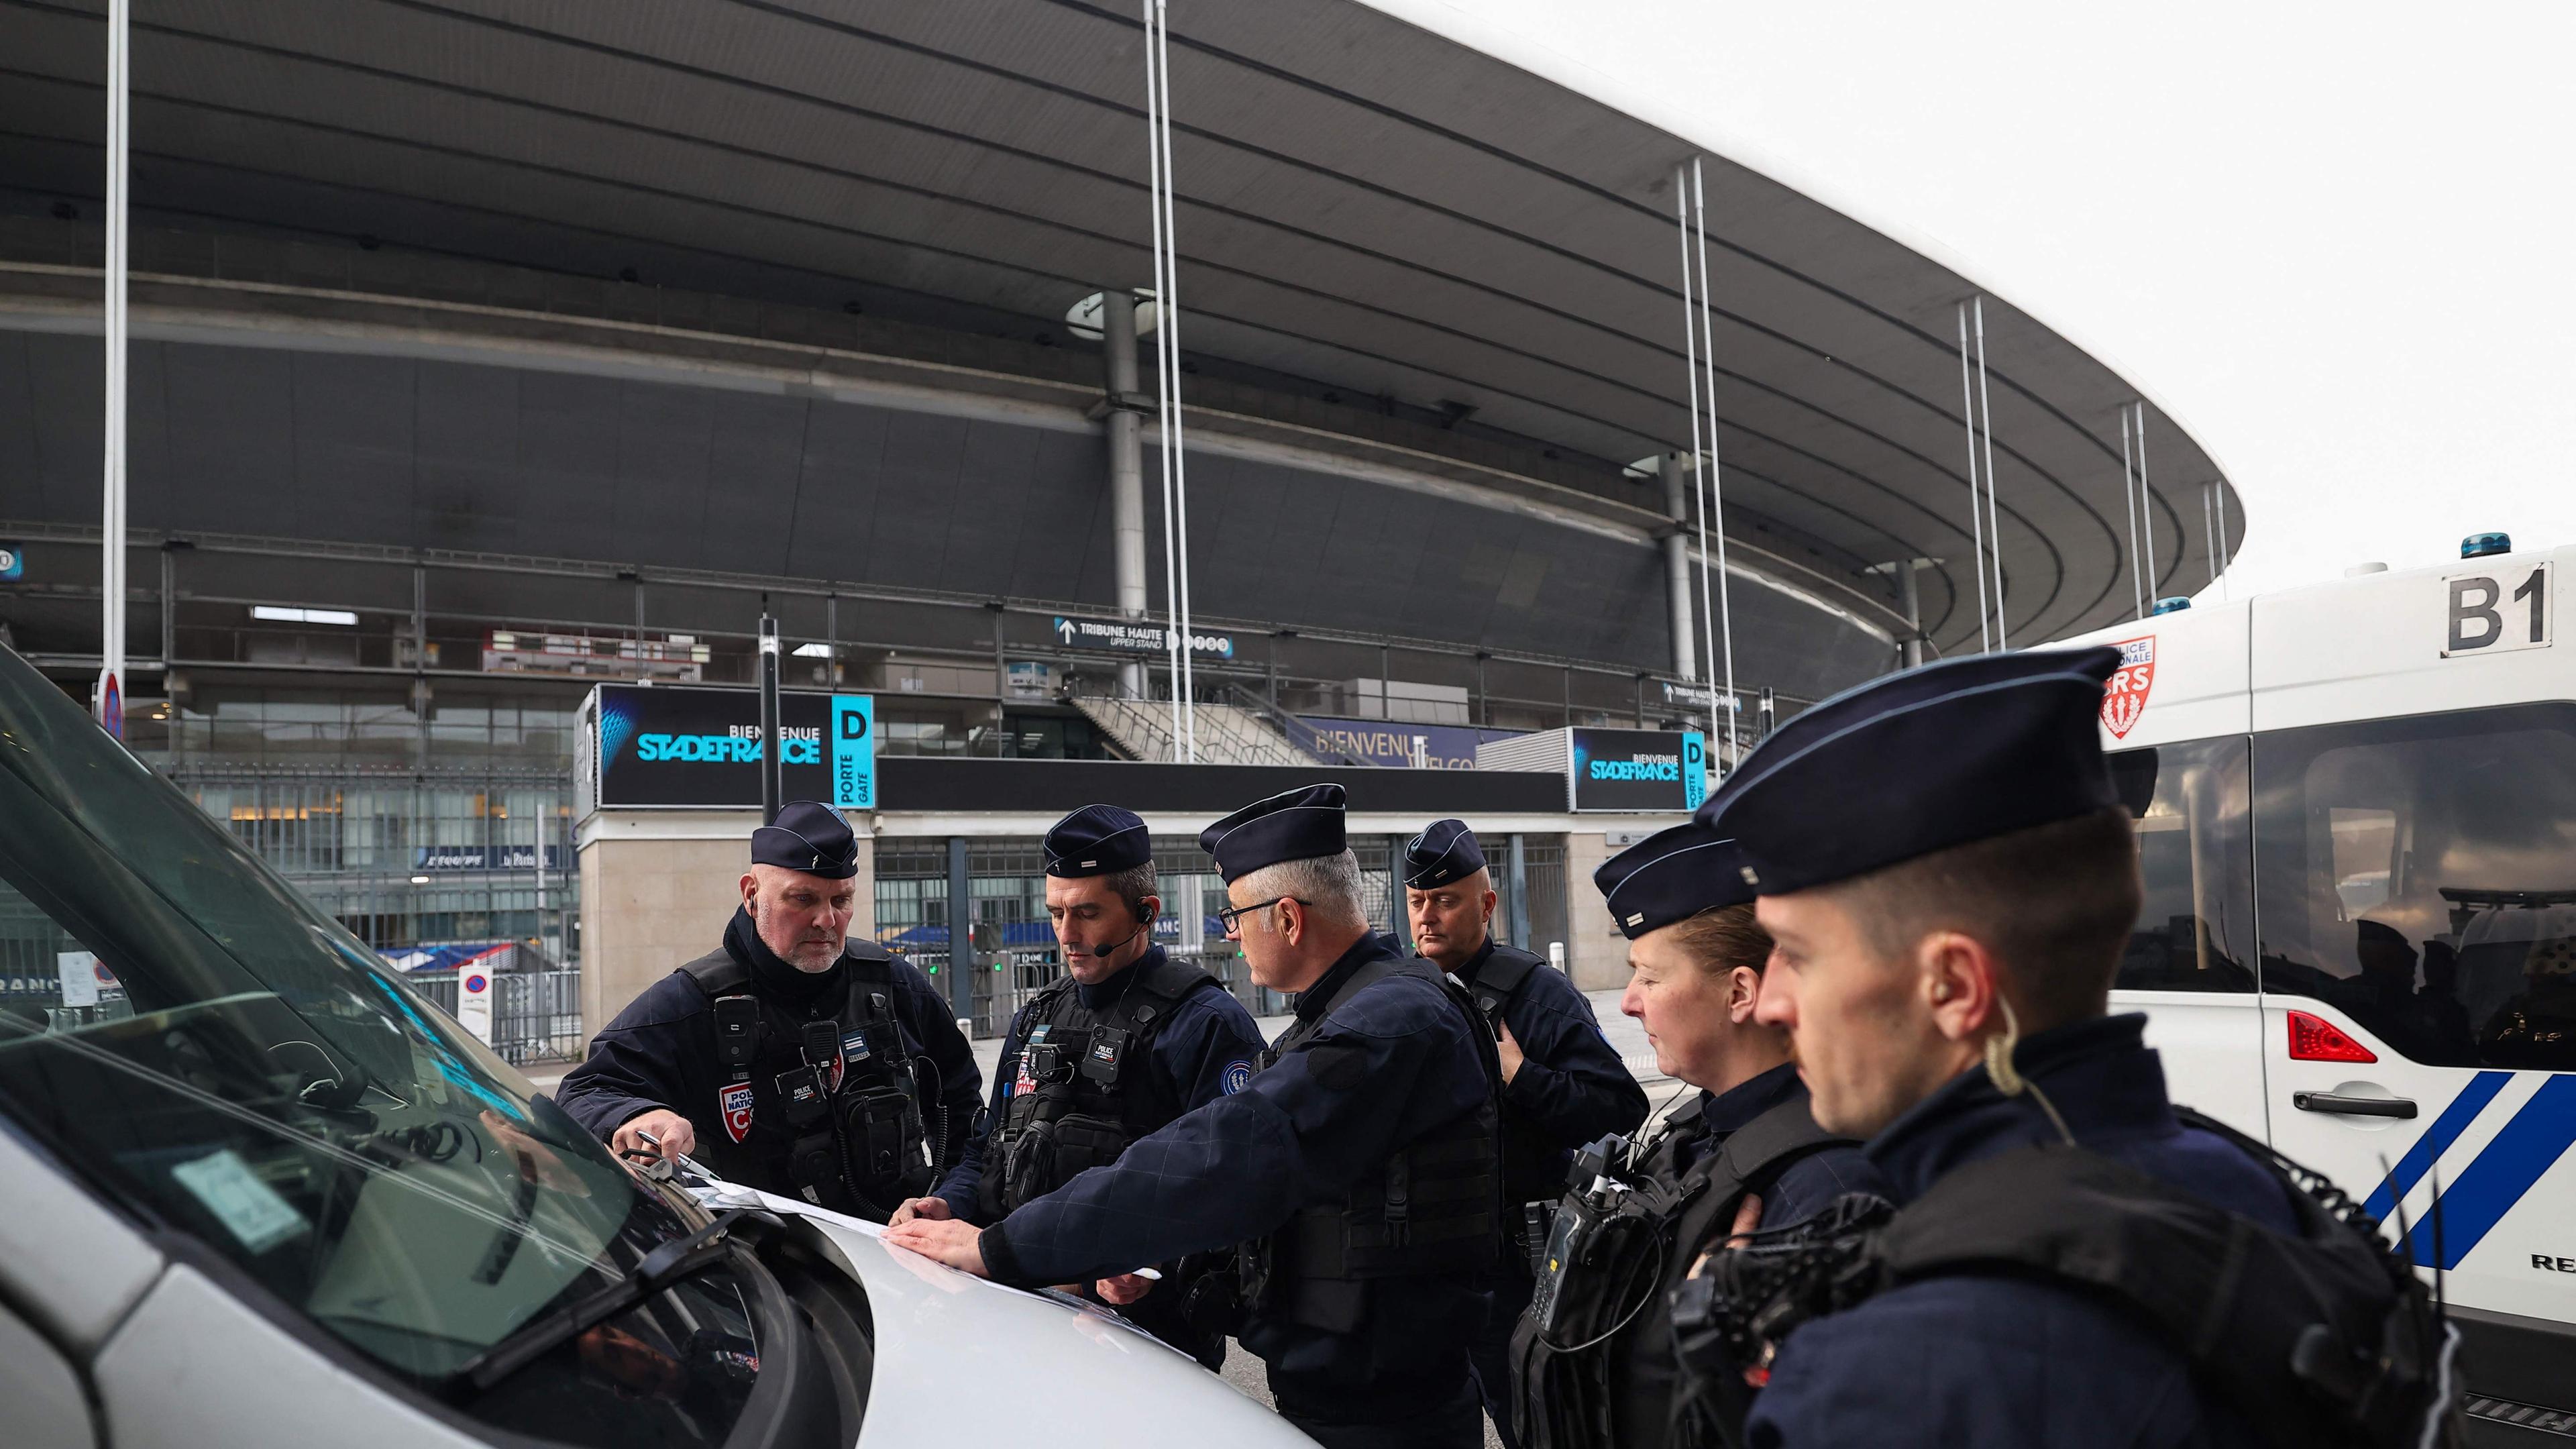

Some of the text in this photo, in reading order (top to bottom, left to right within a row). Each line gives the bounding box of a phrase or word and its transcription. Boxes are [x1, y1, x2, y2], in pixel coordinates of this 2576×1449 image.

[2449, 569, 2544, 651] B1
[1079, 623, 1125, 637] TRIBUNE
[1127, 627, 1163, 641] HAUTE
[1110, 637, 1162, 649] UPPER STAND
[729, 724, 821, 741] BIENENUE
[841, 710, 866, 740] D
[637, 733, 821, 765] STADEFRACE
[1633, 753, 1678, 764] BIENVENUE
[1688, 742, 1701, 764] D
[841, 753, 853, 804] PORTE
[1591, 760, 1680, 782] STADEFRANCE
[858, 772, 868, 804] GATE
[1689, 773, 1697, 808] PORTE
[1097, 1044, 1114, 1055] POLICE
[794, 1085, 811, 1095] POLICE
[2531, 1253, 2576, 1273] RE
